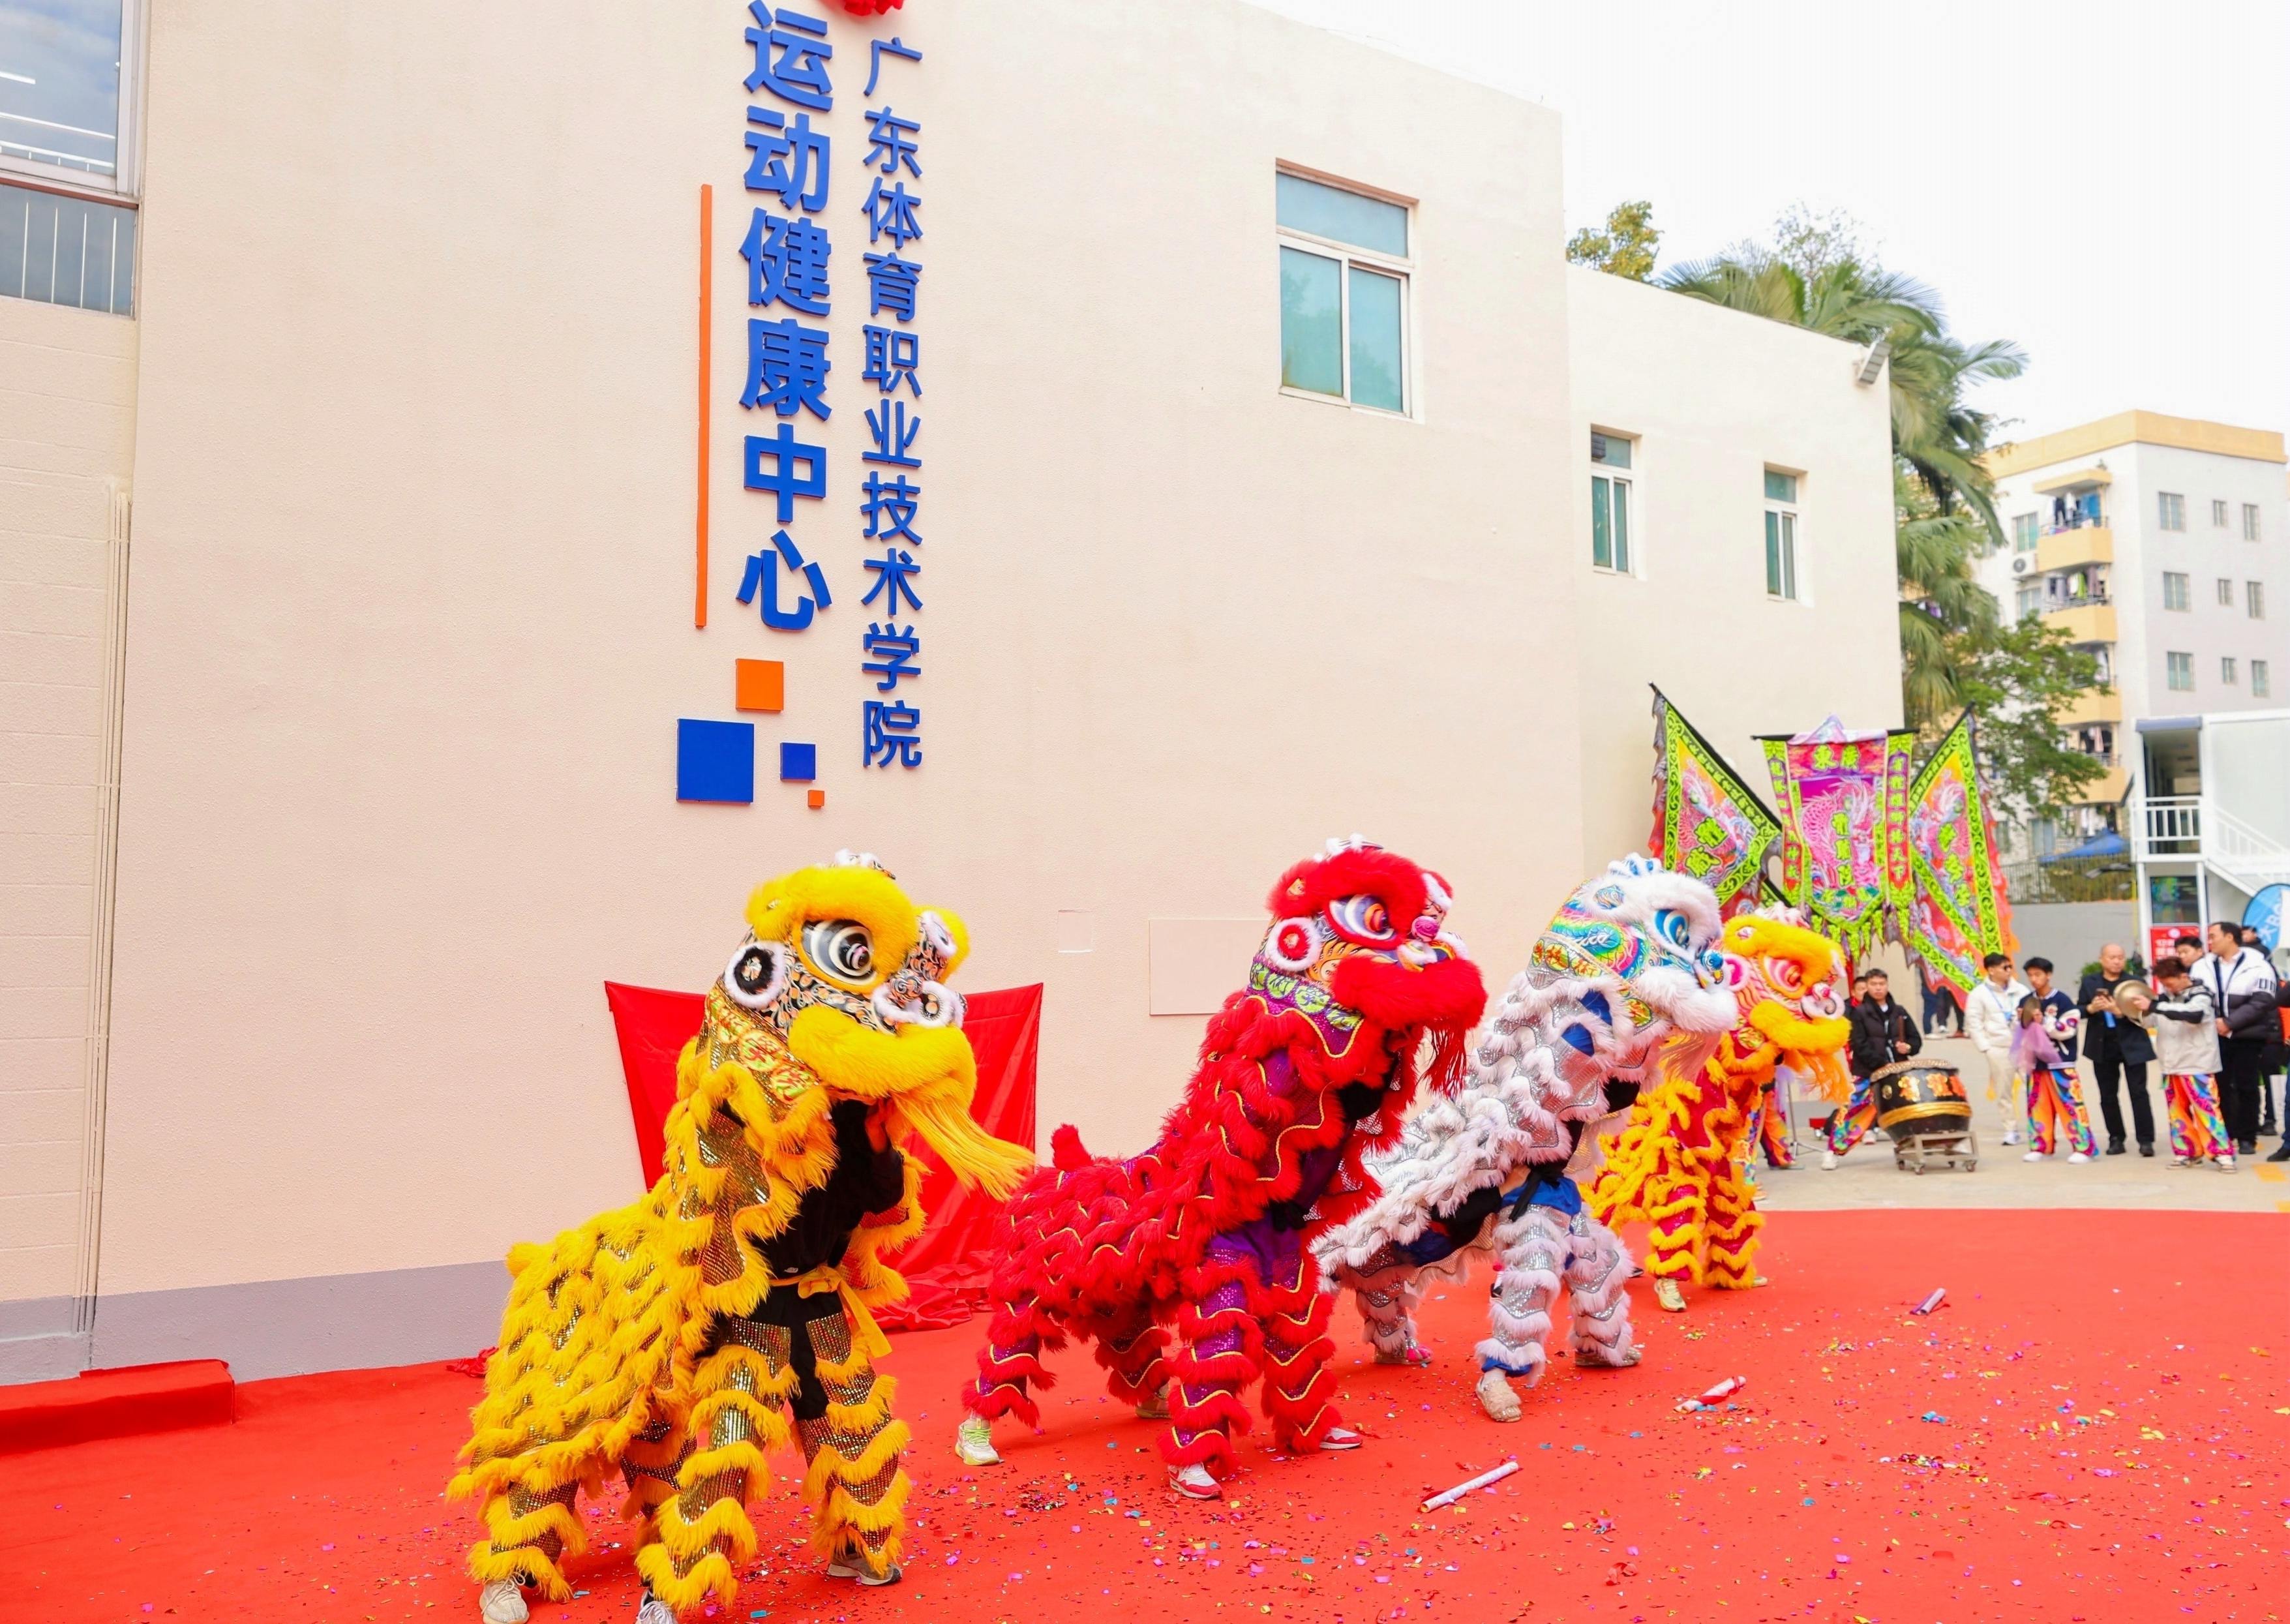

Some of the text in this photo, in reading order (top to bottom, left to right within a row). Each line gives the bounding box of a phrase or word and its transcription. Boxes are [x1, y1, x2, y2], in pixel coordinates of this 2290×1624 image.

[736, 0, 833, 631] 运动健康中心
[860, 37, 923, 768] 广东体育职业技术学院
